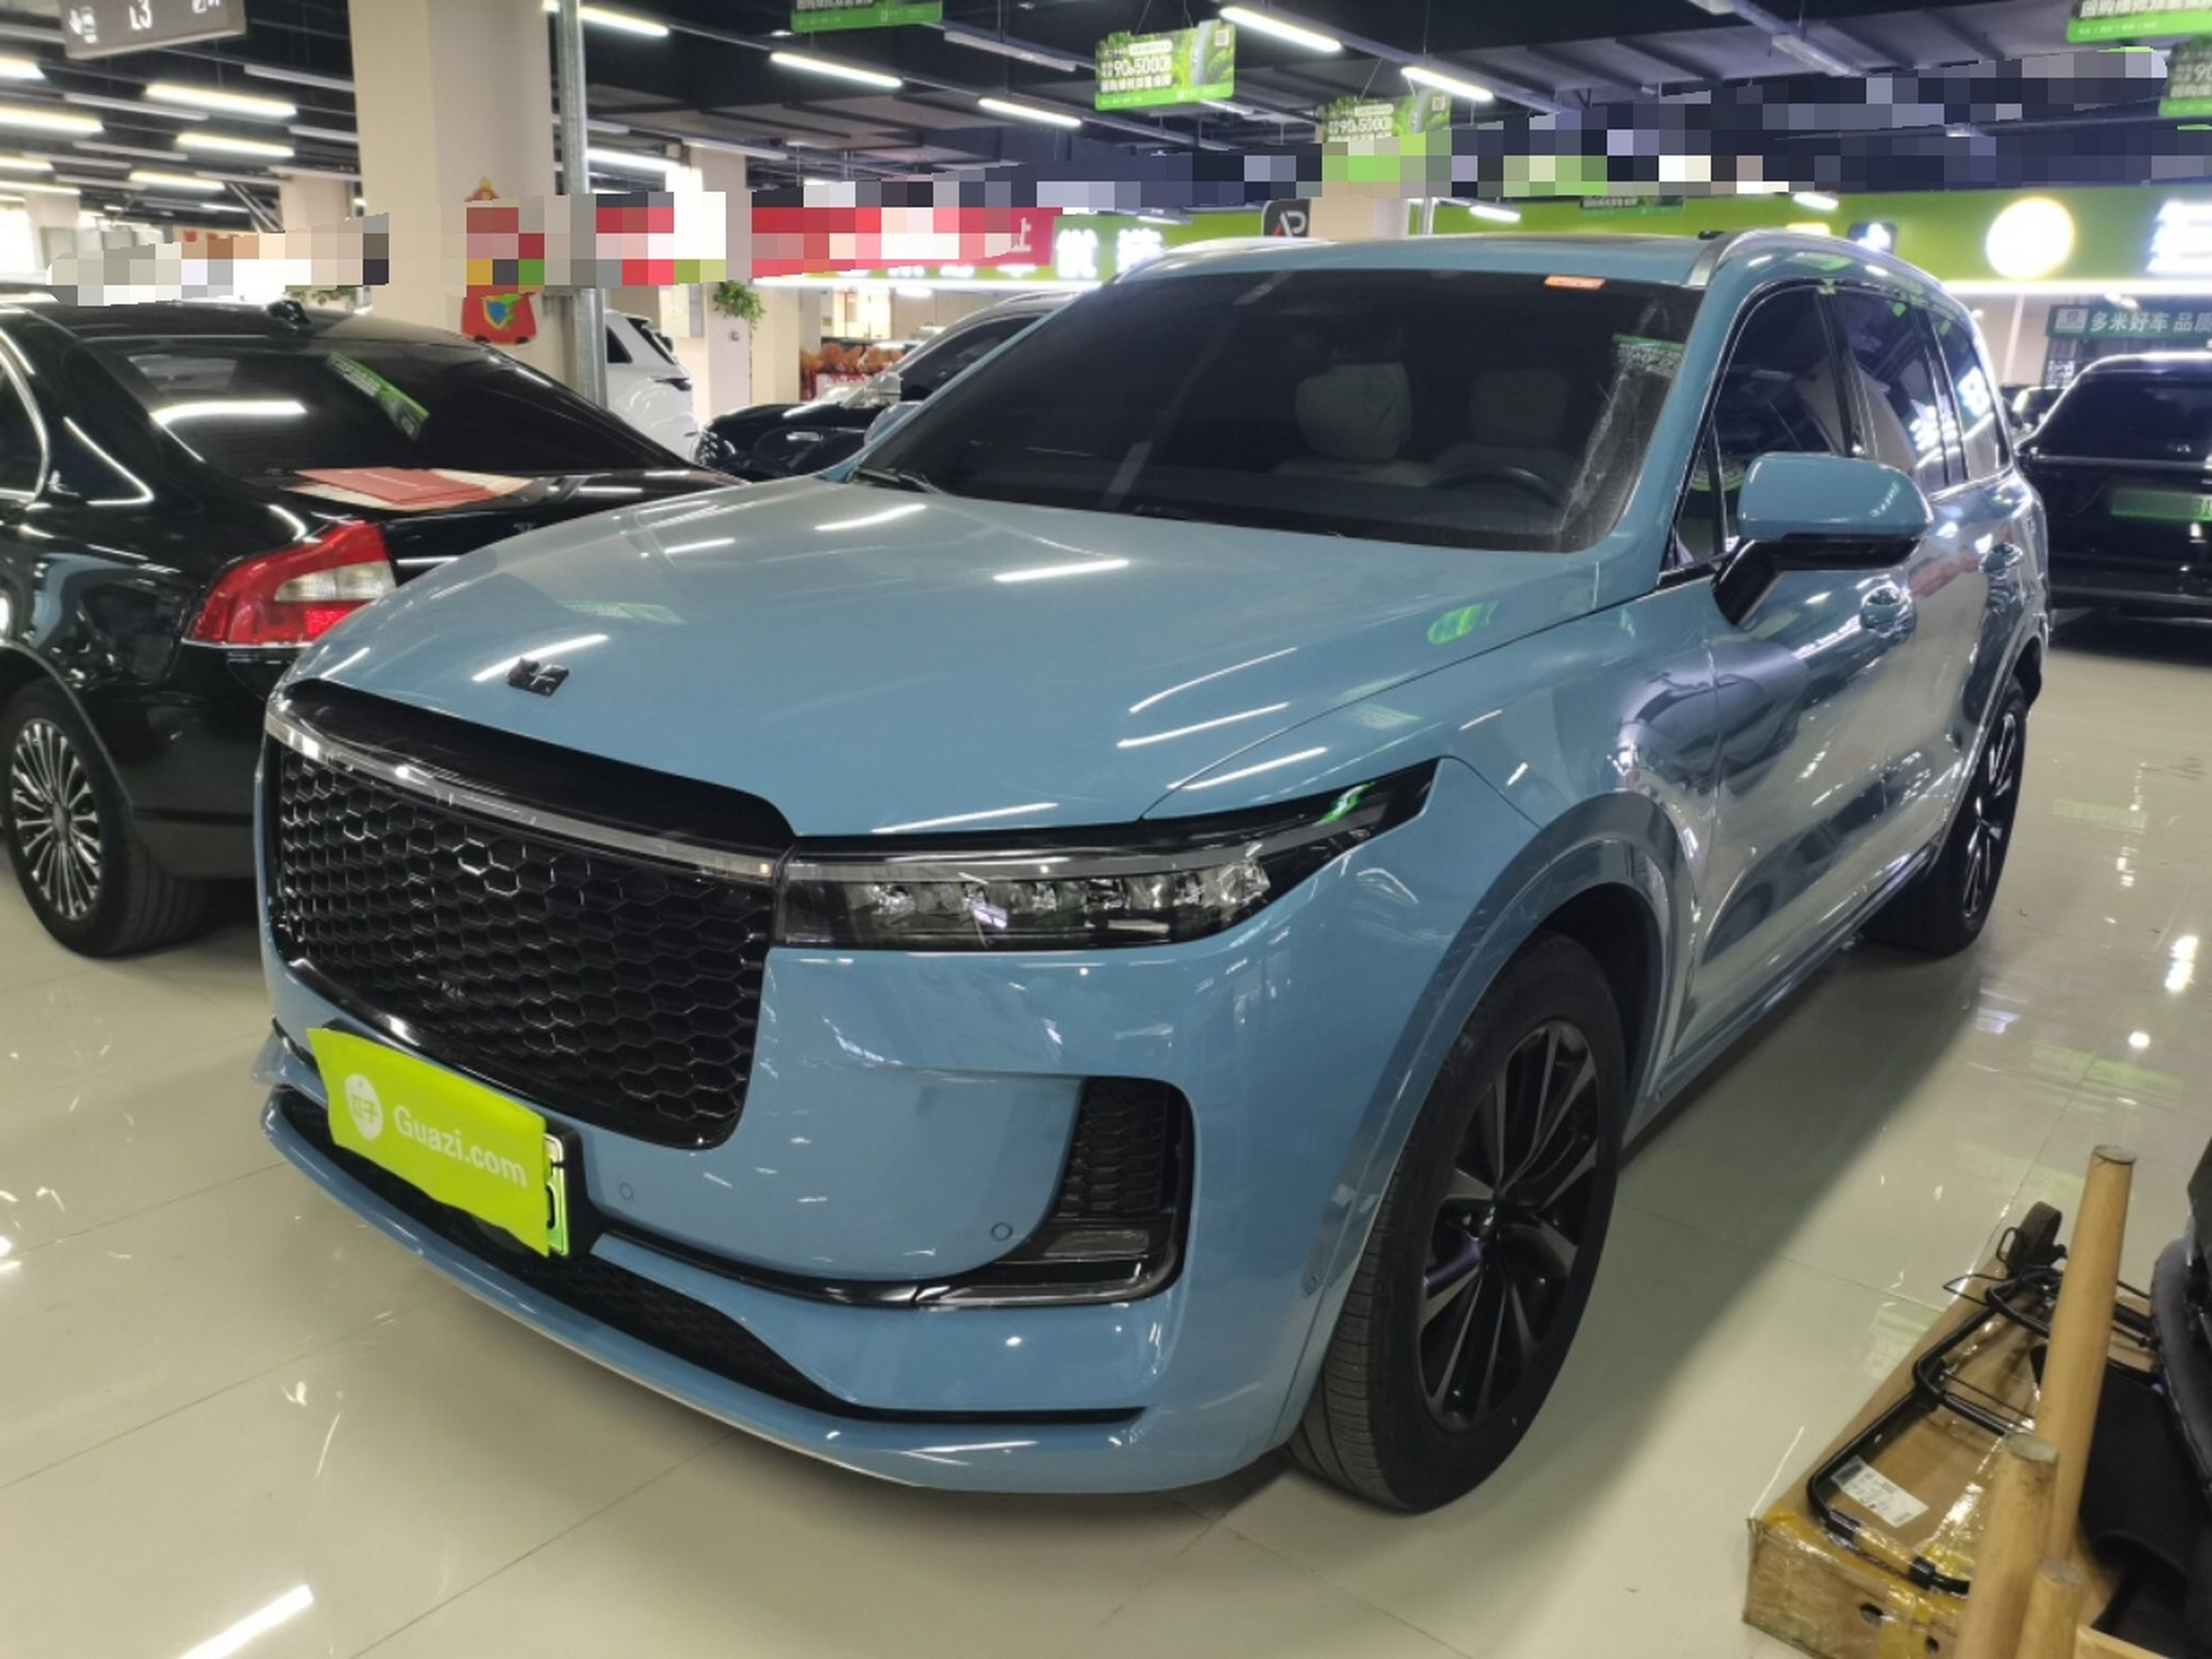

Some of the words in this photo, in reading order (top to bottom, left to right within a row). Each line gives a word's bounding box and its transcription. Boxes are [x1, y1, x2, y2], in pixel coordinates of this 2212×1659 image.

[2090, 310, 2169, 332] 多米好车
[393, 1104, 528, 1188] Guazi.com
